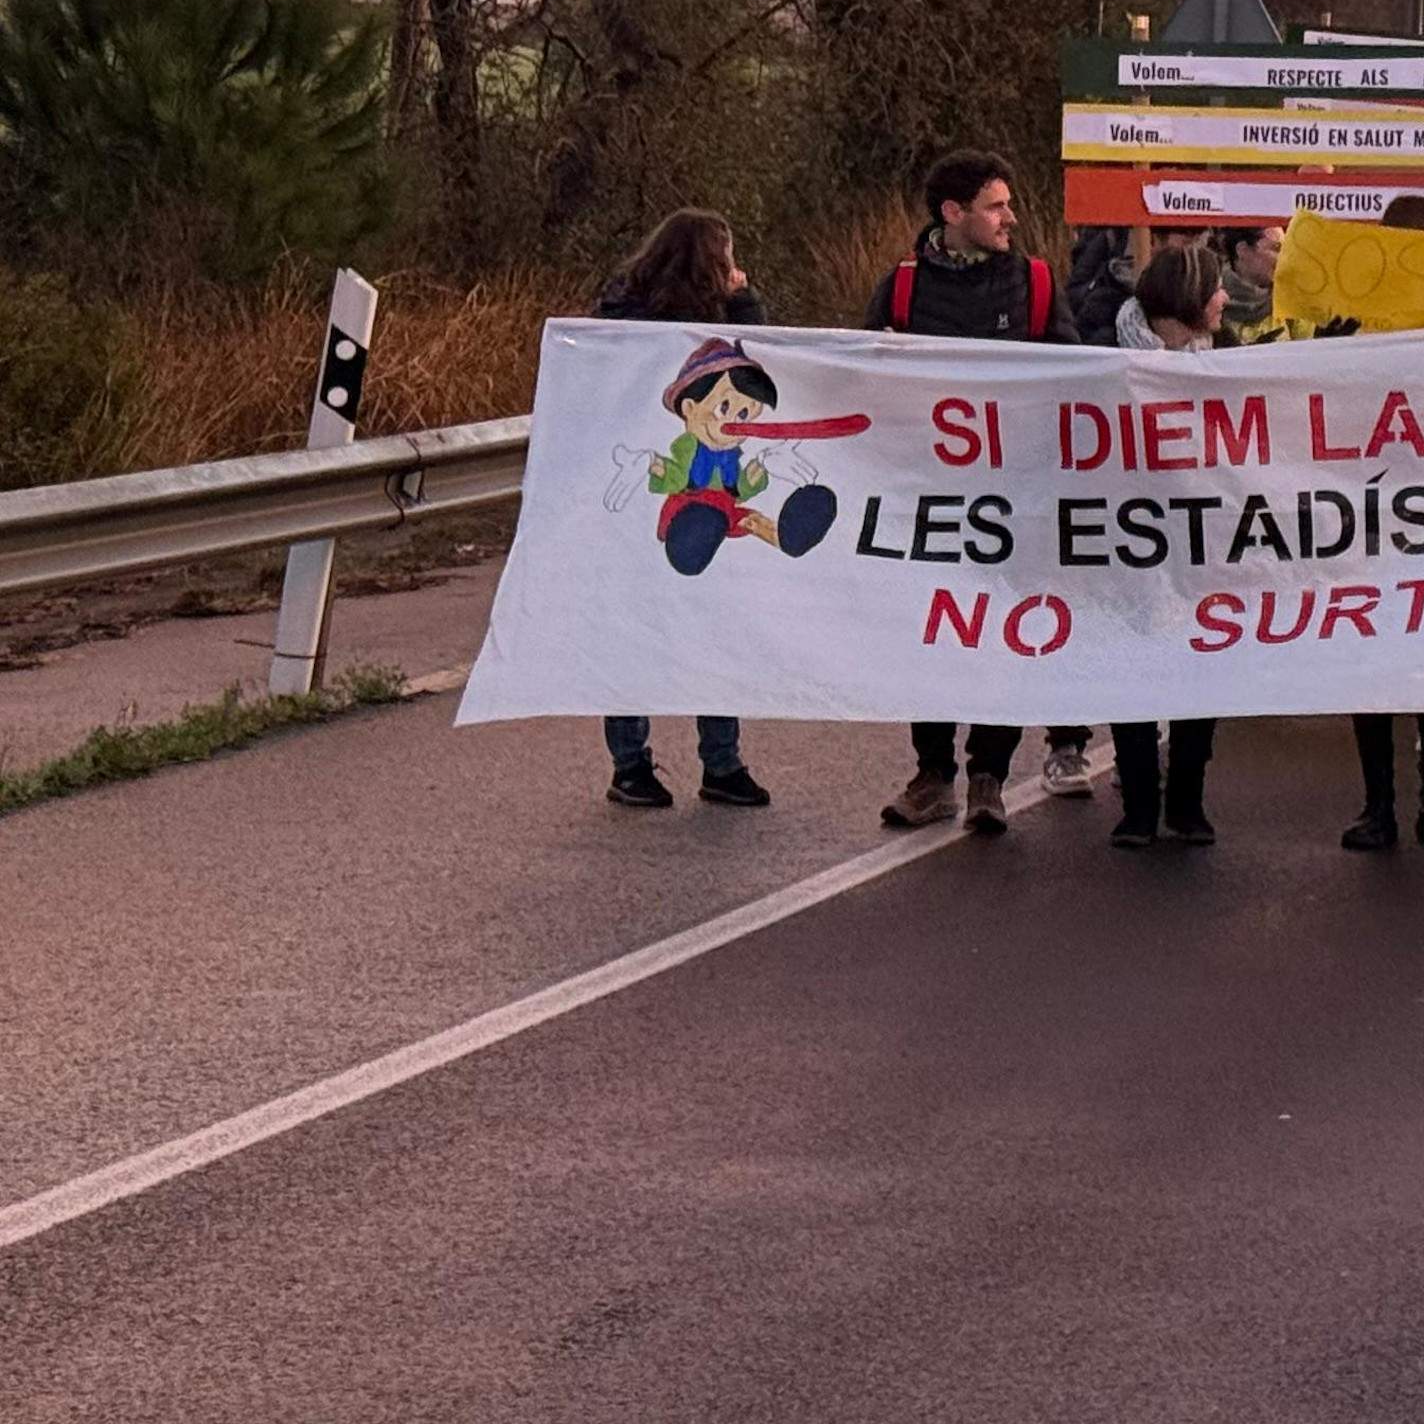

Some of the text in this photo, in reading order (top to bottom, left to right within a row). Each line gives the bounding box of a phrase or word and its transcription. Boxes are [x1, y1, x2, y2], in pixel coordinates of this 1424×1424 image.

[1267, 68, 1343, 87] RESPECTE
[1360, 69, 1389, 86] ALS
[1243, 122, 1320, 145] INVERSIÓ
[1328, 129, 1348, 147] EN
[1353, 129, 1405, 148] SALUT
[1295, 192, 1383, 212] OBJECTIUS
[932, 397, 1003, 470] SI
[1059, 395, 1271, 471] DIEM
[856, 494, 1014, 564] LES
[922, 589, 1073, 657] NO
